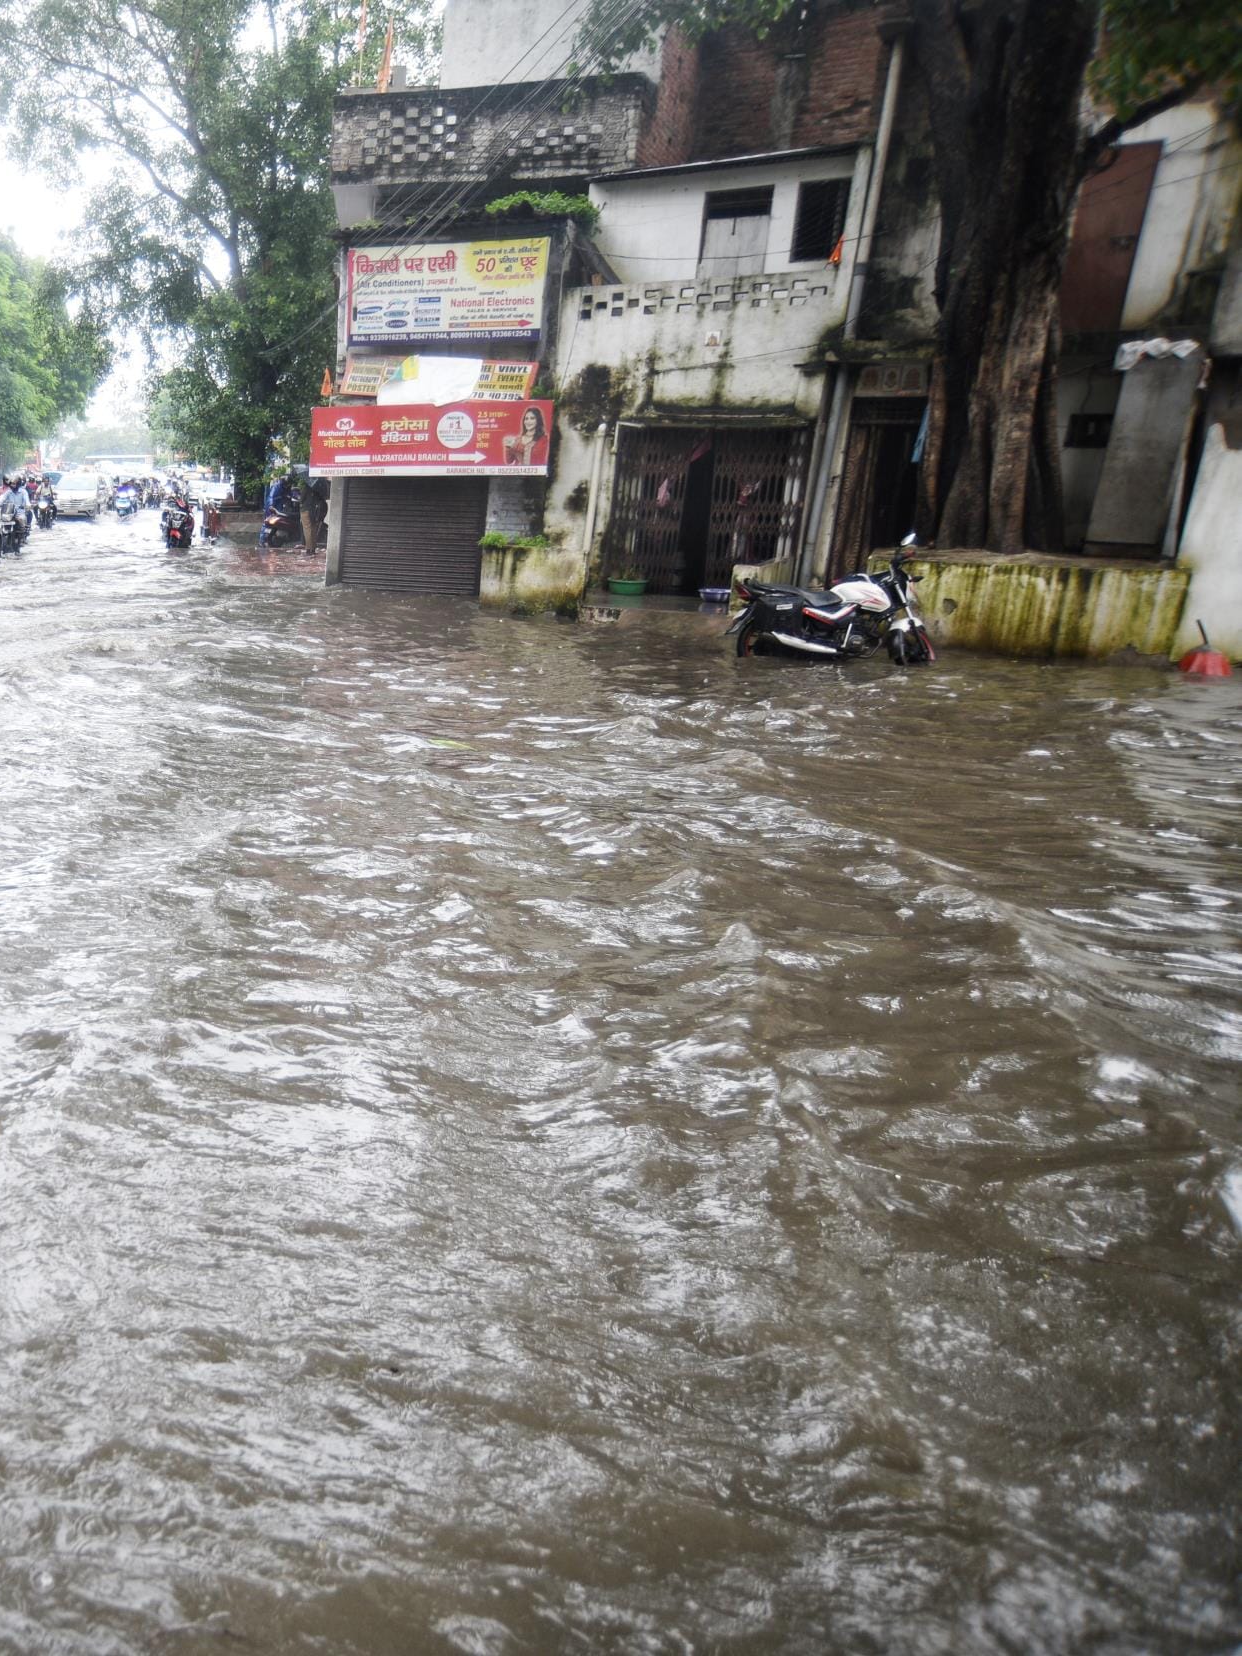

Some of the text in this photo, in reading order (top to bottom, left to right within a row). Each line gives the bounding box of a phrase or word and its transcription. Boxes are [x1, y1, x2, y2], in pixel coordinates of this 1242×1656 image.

[404, 258, 424, 272] पर
[427, 249, 457, 272] एसी
[475, 257, 496, 273] 50
[373, 278, 424, 288] Conditioners)
[450, 296, 535, 308] National Electronics
[498, 365, 528, 373] VINYL
[497, 374, 524, 382] EVENTS
[347, 383, 376, 392] POSTER
[381, 416, 430, 431] भरोसा
[323, 436, 367, 448] गोल्ड लोन
[381, 431, 429, 443] इंडिया का
[372, 452, 447, 462] HAZRATGANJ BRANCH
